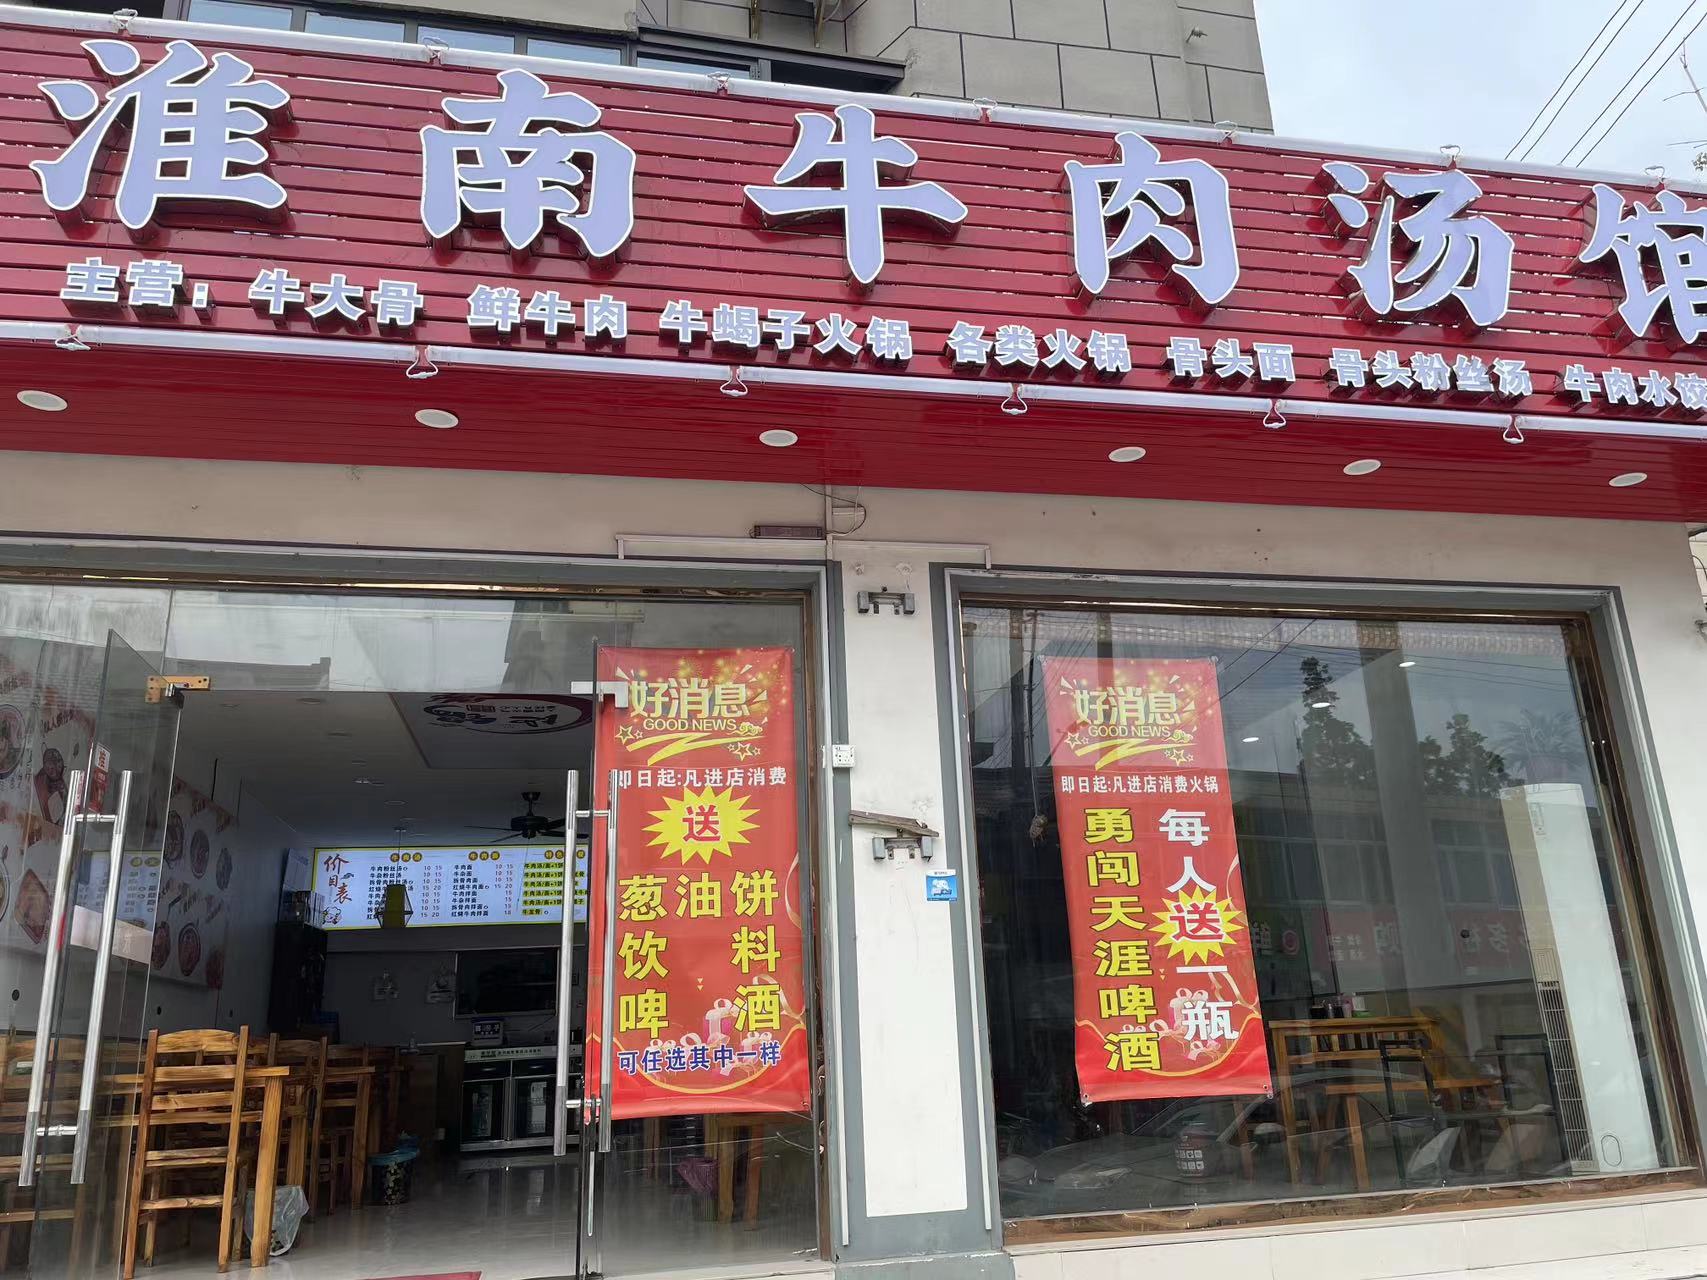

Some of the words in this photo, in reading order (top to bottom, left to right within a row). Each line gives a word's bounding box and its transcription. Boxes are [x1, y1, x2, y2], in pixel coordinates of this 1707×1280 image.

[248, 268, 423, 327] 牛大骨
[466, 284, 628, 338] 鲜牛肉
[659, 299, 912, 360] 牛蝎子火锅
[947, 321, 1132, 373] 各类火锅
[1166, 336, 1295, 382] 骨头面
[1329, 347, 1533, 396] 骨头粉丝汤
[630, 677, 749, 719] 好消息
[1073, 686, 1181, 726] 好消息
[643, 718, 690, 731] GOOD
[693, 718, 737, 731] NEWS
[1088, 725, 1129, 738] GOOD
[1132, 725, 1171, 738] NEWS
[617, 766, 786, 788] 即日起:凡进店消费
[1061, 775, 1219, 794] 即日起:凡进店消费火锅
[683, 804, 721, 842] 送
[323, 853, 353, 905] 价目表
[618, 870, 779, 921] 葱油饼
[1084, 808, 1162, 1072] 勇闯天涯啤酒
[617, 1041, 782, 1075] 可任选其中一样
